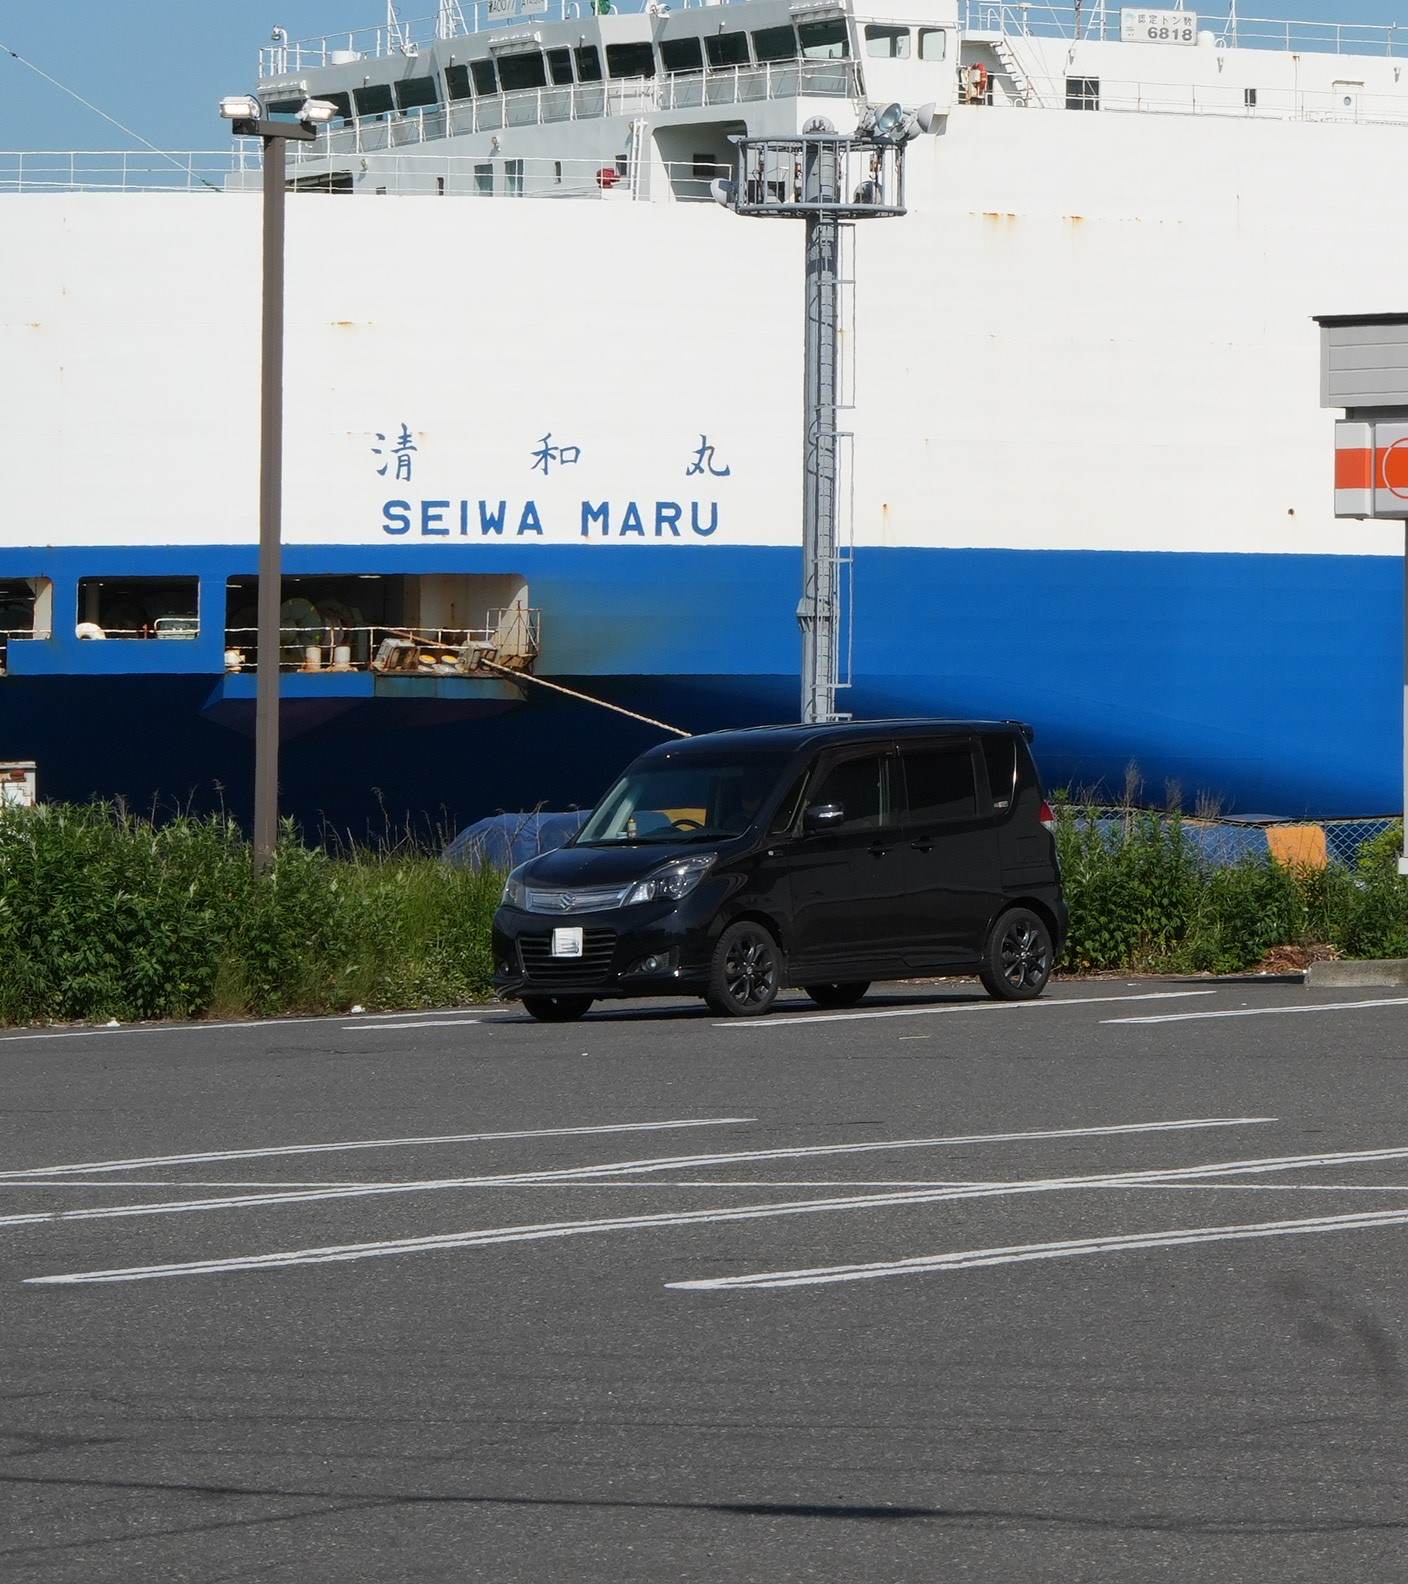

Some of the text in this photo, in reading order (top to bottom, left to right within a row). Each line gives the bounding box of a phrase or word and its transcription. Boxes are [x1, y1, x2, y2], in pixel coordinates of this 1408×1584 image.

[1147, 26, 1193, 41] 6818
[382, 499, 719, 537] SEIWA MARU
